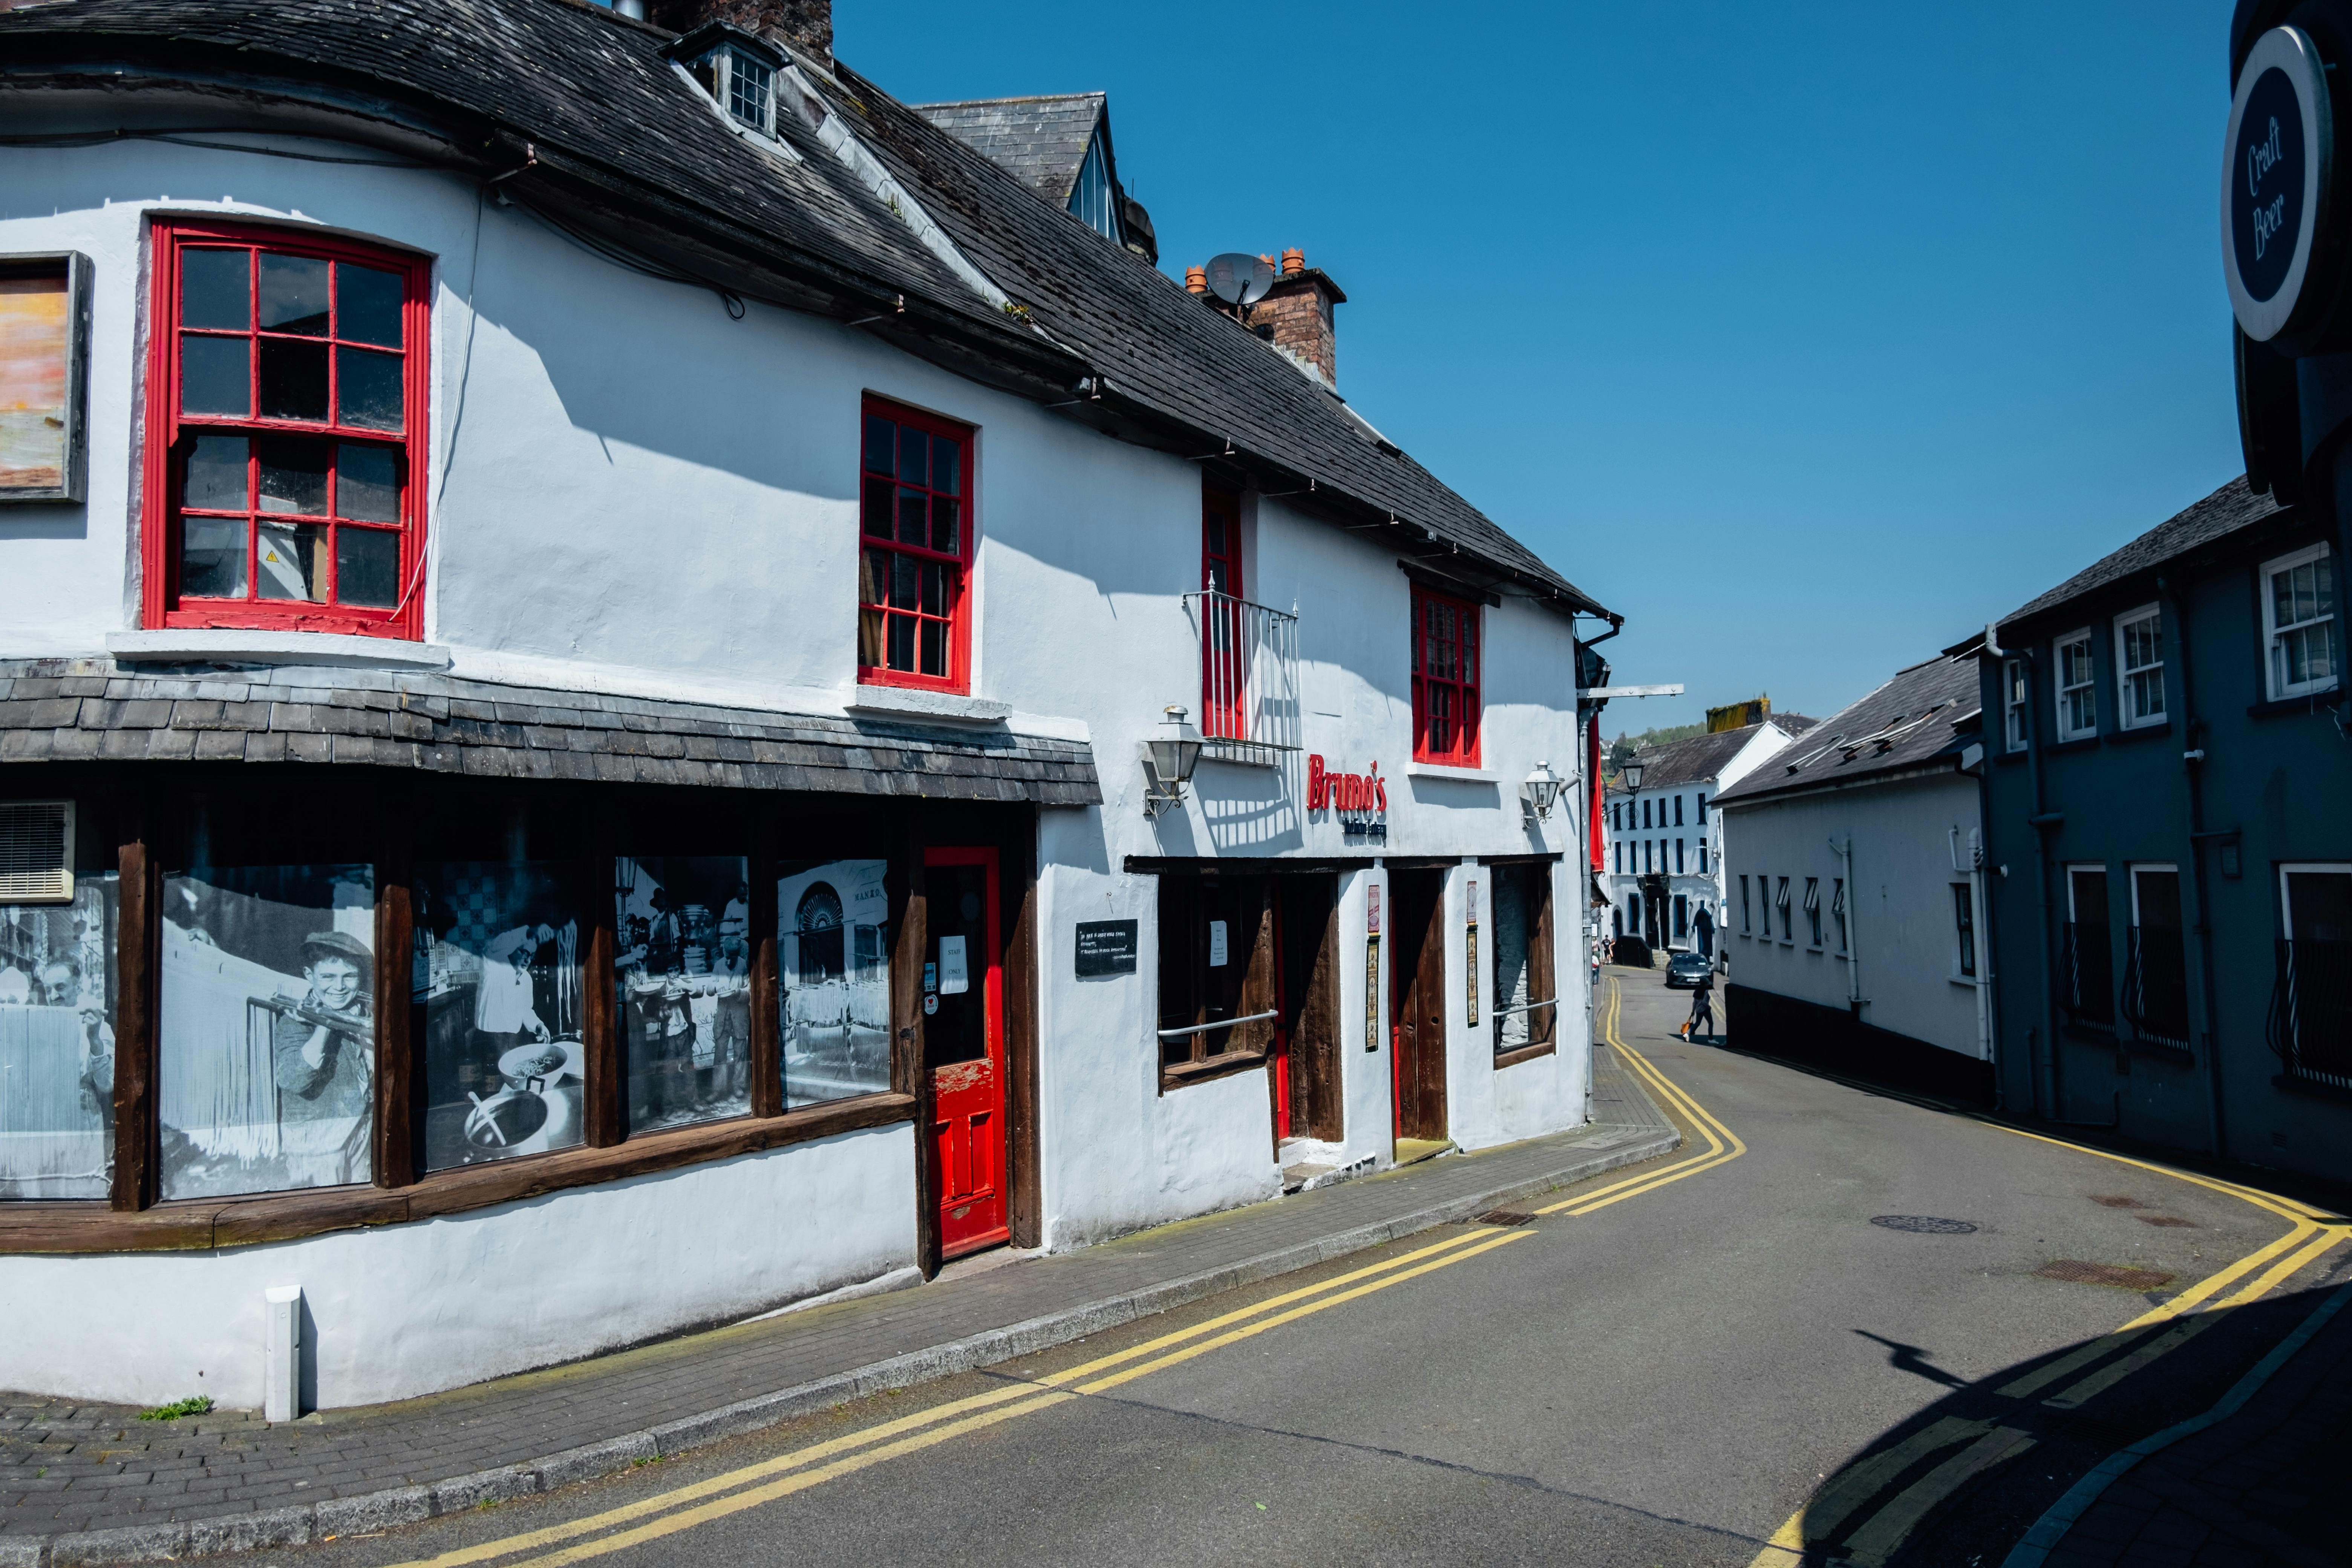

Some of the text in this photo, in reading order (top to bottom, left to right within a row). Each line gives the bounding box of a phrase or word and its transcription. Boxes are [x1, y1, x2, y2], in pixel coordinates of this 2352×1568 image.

[2248, 116, 2282, 197] Craft
[2253, 194, 2284, 261] Beer
[1307, 754, 1387, 812] Bruno's
